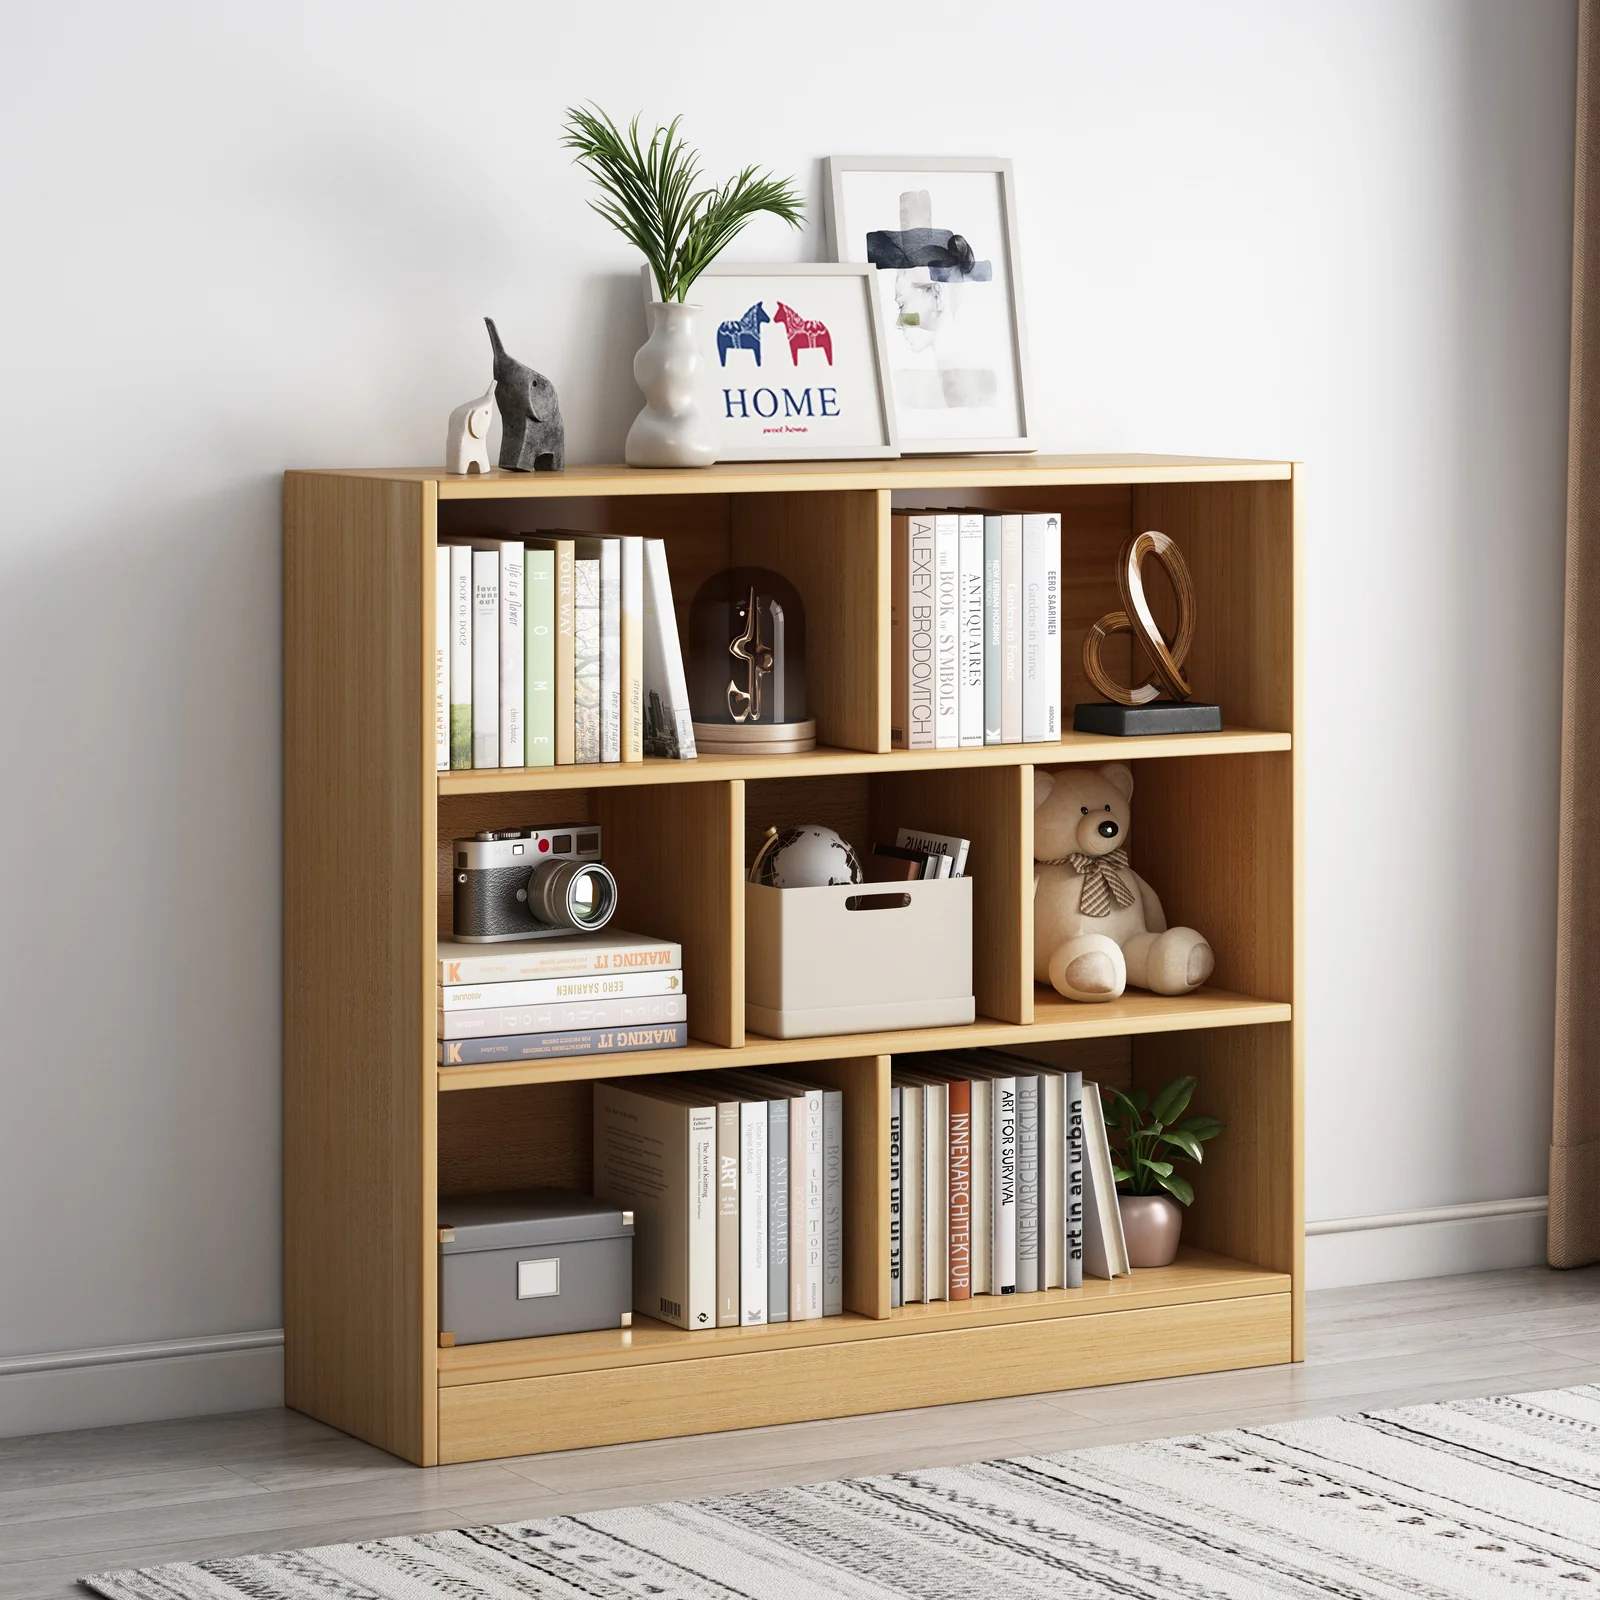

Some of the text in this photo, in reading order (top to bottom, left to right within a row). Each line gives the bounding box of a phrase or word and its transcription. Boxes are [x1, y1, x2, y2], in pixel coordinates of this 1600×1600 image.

[722, 387, 841, 418] HOME
[505, 563, 522, 578] life
[510, 581, 519, 589] is
[505, 599, 522, 627] flower
[560, 550, 571, 637] YOUR WAY
[992, 559, 1000, 646] NEW URBAN HOUSING
[1047, 570, 1057, 636] EERO SAARINEN
[912, 522, 932, 735] ALEXEY BRODOVITCH
[939, 551, 955, 716] THE BOOK OF SYMBOLS
[967, 574, 981, 687] ANTIQUAIRES
[1007, 583, 1018, 682] Gardens in France
[1028, 583, 1040, 681] Gardens in France
[534, 571, 548, 745] HOME
[612, 691, 621, 707] love
[631, 679, 640, 715] stronger
[610, 722, 619, 752] prague
[633, 718, 642, 737] than
[594, 950, 671, 970] MAKING IT
[452, 993, 482, 1001] ASSOULINE
[556, 980, 624, 996] EERO SAARINEN
[598, 1028, 677, 1048] MAKING IT
[756, 1121, 764, 1140] Detail
[1002, 1090, 1015, 1206] ART FOR SURVIVAL
[721, 1155, 736, 1190] ART
[756, 1148, 764, 1193] Contemporary
[809, 1099, 820, 1265] Over the Top
[827, 1145, 840, 1190] BOOK
[1019, 1088, 1037, 1261] INNENARCHITEKTUR
[1066, 1100, 1082, 1260] art in an urban
[720, 1209, 737, 1217] Century
[774, 1156, 787, 1265] ANTIQUAIRES
[951, 1113, 969, 1289] INNENARCHITEKTUR
[827, 1206, 840, 1286] SYMBOLS
